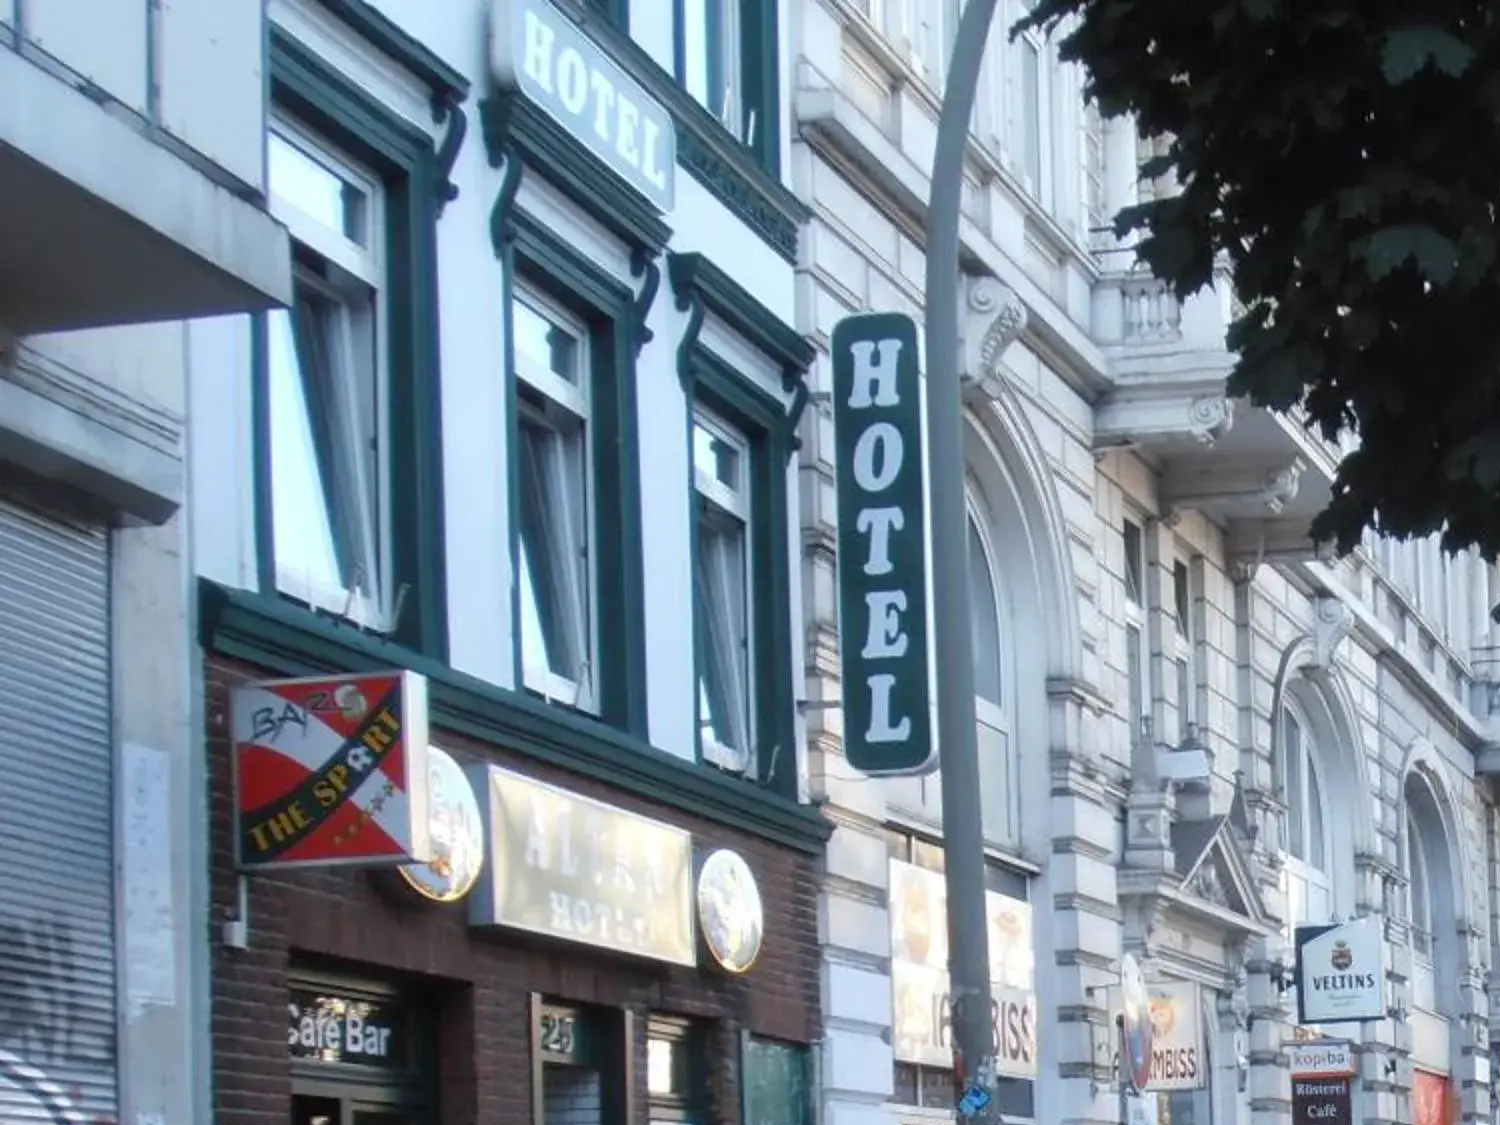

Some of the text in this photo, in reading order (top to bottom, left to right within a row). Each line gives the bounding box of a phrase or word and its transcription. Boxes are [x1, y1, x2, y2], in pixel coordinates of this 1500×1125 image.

[523, 9, 666, 191] HOTEL
[847, 337, 911, 743] HOTEL
[249, 800, 314, 851] THE
[1312, 973, 1375, 992] VELTINS
[345, 1014, 392, 1056] Bar
[1307, 1102, 1337, 1119] Café
